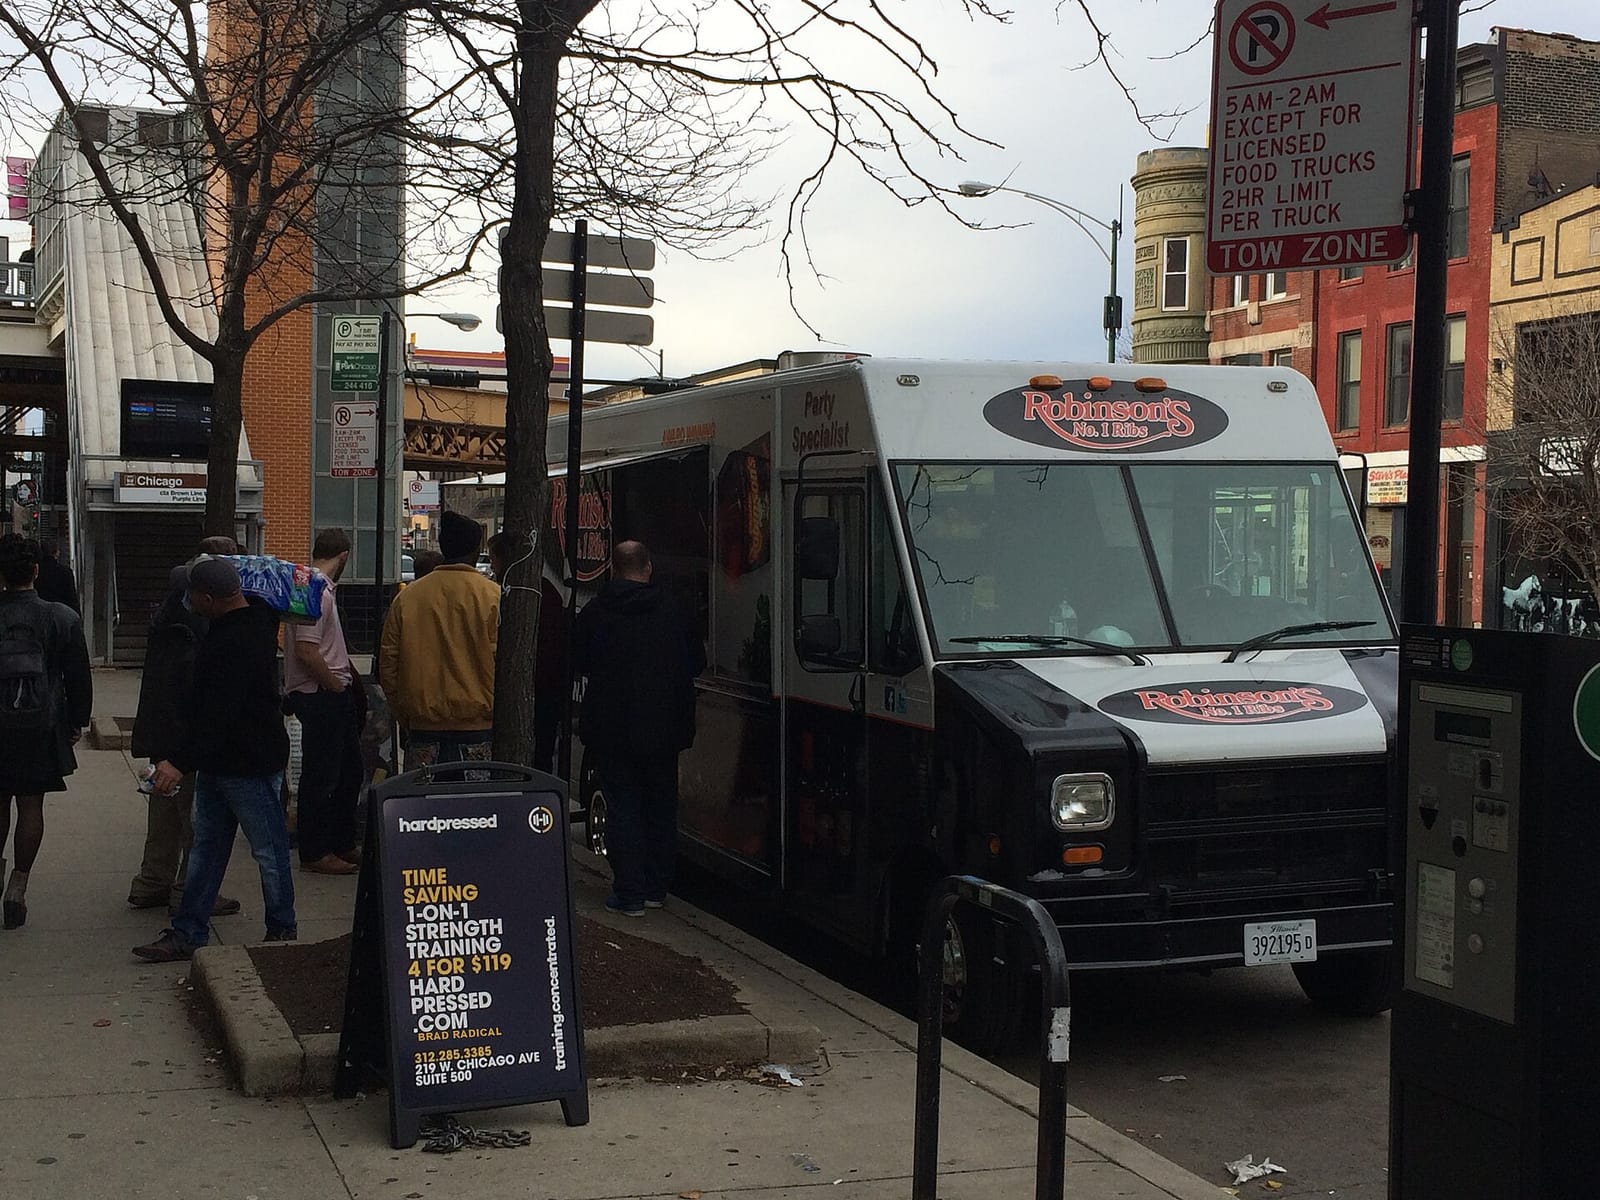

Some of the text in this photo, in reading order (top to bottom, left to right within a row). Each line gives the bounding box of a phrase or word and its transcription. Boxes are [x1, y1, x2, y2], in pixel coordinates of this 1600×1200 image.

[1226, 82, 1336, 116] 5AM-2AM
[1225, 103, 1361, 140] EXCEPT FOR
[1223, 132, 1327, 163] LICENSED
[1222, 150, 1376, 186] FOOD TRUCKS
[1222, 179, 1333, 209] 2HR LIMIT
[1220, 202, 1341, 233] PER TRUCK
[1220, 231, 1389, 269] TOW ZONE
[804, 391, 836, 420] Party
[793, 423, 850, 452] Specialist
[1072, 422, 1099, 438] No.
[1112, 422, 1149, 438] Ribs
[137, 475, 183, 488] Chicago
[352, 468, 373, 476] ZONE
[1200, 705, 1231, 717] No.
[1244, 705, 1286, 715] Ribs
[399, 814, 498, 833] hardpressed
[402, 868, 447, 886] TIME
[403, 884, 479, 905] SAVING
[406, 903, 469, 923] 1-ON-1
[406, 918, 503, 942] STRENGTH
[406, 936, 502, 960] TRAINING
[1252, 933, 1301, 956] 392195
[407, 953, 512, 977] 4 FOR $119
[409, 975, 465, 997] HARD
[545, 916, 566, 1071] training.concentrated.
[411, 991, 493, 1015] PRESSED
[413, 1011, 469, 1033] .COM
[418, 1027, 502, 1042] BRAD RADICAL
[414, 1046, 492, 1064] 312.285.3385
[415, 1052, 541, 1075] 219 W. CHICAGO AVE
[415, 1070, 472, 1087] SUITE 500
